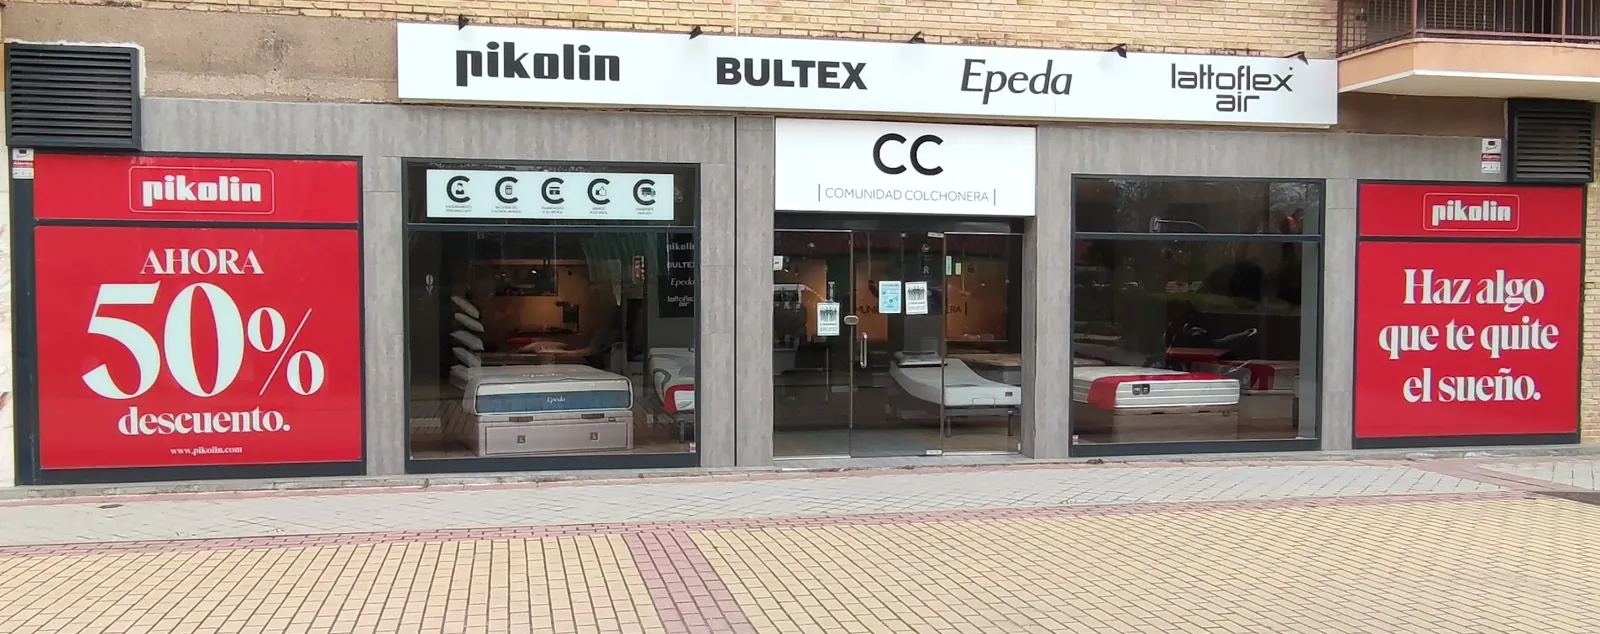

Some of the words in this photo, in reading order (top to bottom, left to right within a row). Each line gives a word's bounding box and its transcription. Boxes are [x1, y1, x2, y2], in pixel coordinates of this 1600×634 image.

[456, 42, 620, 87] pikolin
[716, 57, 868, 90] BULTEX
[1171, 62, 1294, 93] lattoflex
[961, 58, 1073, 105] Epeda
[1215, 92, 1260, 113] air
[873, 133, 944, 176] CC
[142, 174, 262, 207] pikolin
[825, 187, 903, 201] COMUNIDAD
[905, 188, 989, 202] COLCHONERA
[1431, 199, 1511, 227] pikolin
[139, 248, 264, 275] AHORA
[1403, 269, 1472, 305] Haz
[1475, 269, 1545, 312] algo
[82, 280, 325, 399] 50%
[1378, 324, 1440, 360] que
[1445, 318, 1475, 351] te
[1480, 316, 1559, 359] quite
[1403, 367, 1432, 403] el
[1438, 367, 1542, 403] sueño.
[118, 406, 291, 435] descuento.
[170, 446, 243, 456] www.pikolin.com
